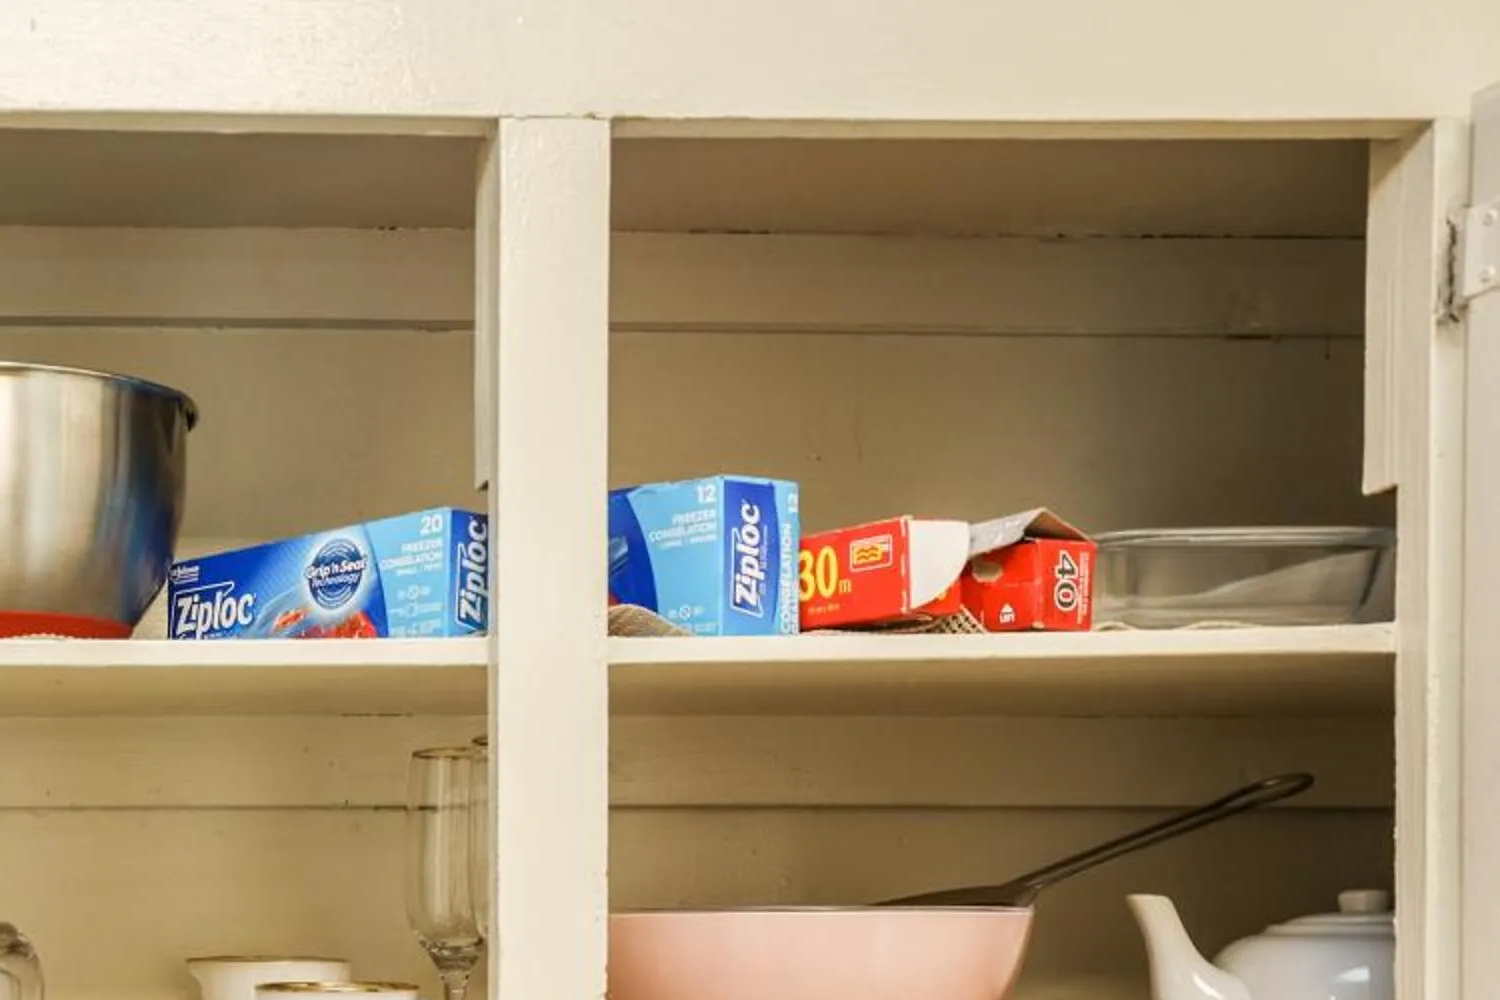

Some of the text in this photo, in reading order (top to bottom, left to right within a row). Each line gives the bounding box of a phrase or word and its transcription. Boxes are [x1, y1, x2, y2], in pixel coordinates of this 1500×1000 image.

[696, 484, 717, 503] 12
[419, 514, 443, 535] 20
[460, 519, 488, 623] Ziploc
[735, 502, 764, 607] Ziploc
[1055, 550, 1078, 612] 40
[176, 591, 253, 640] Ziploc
